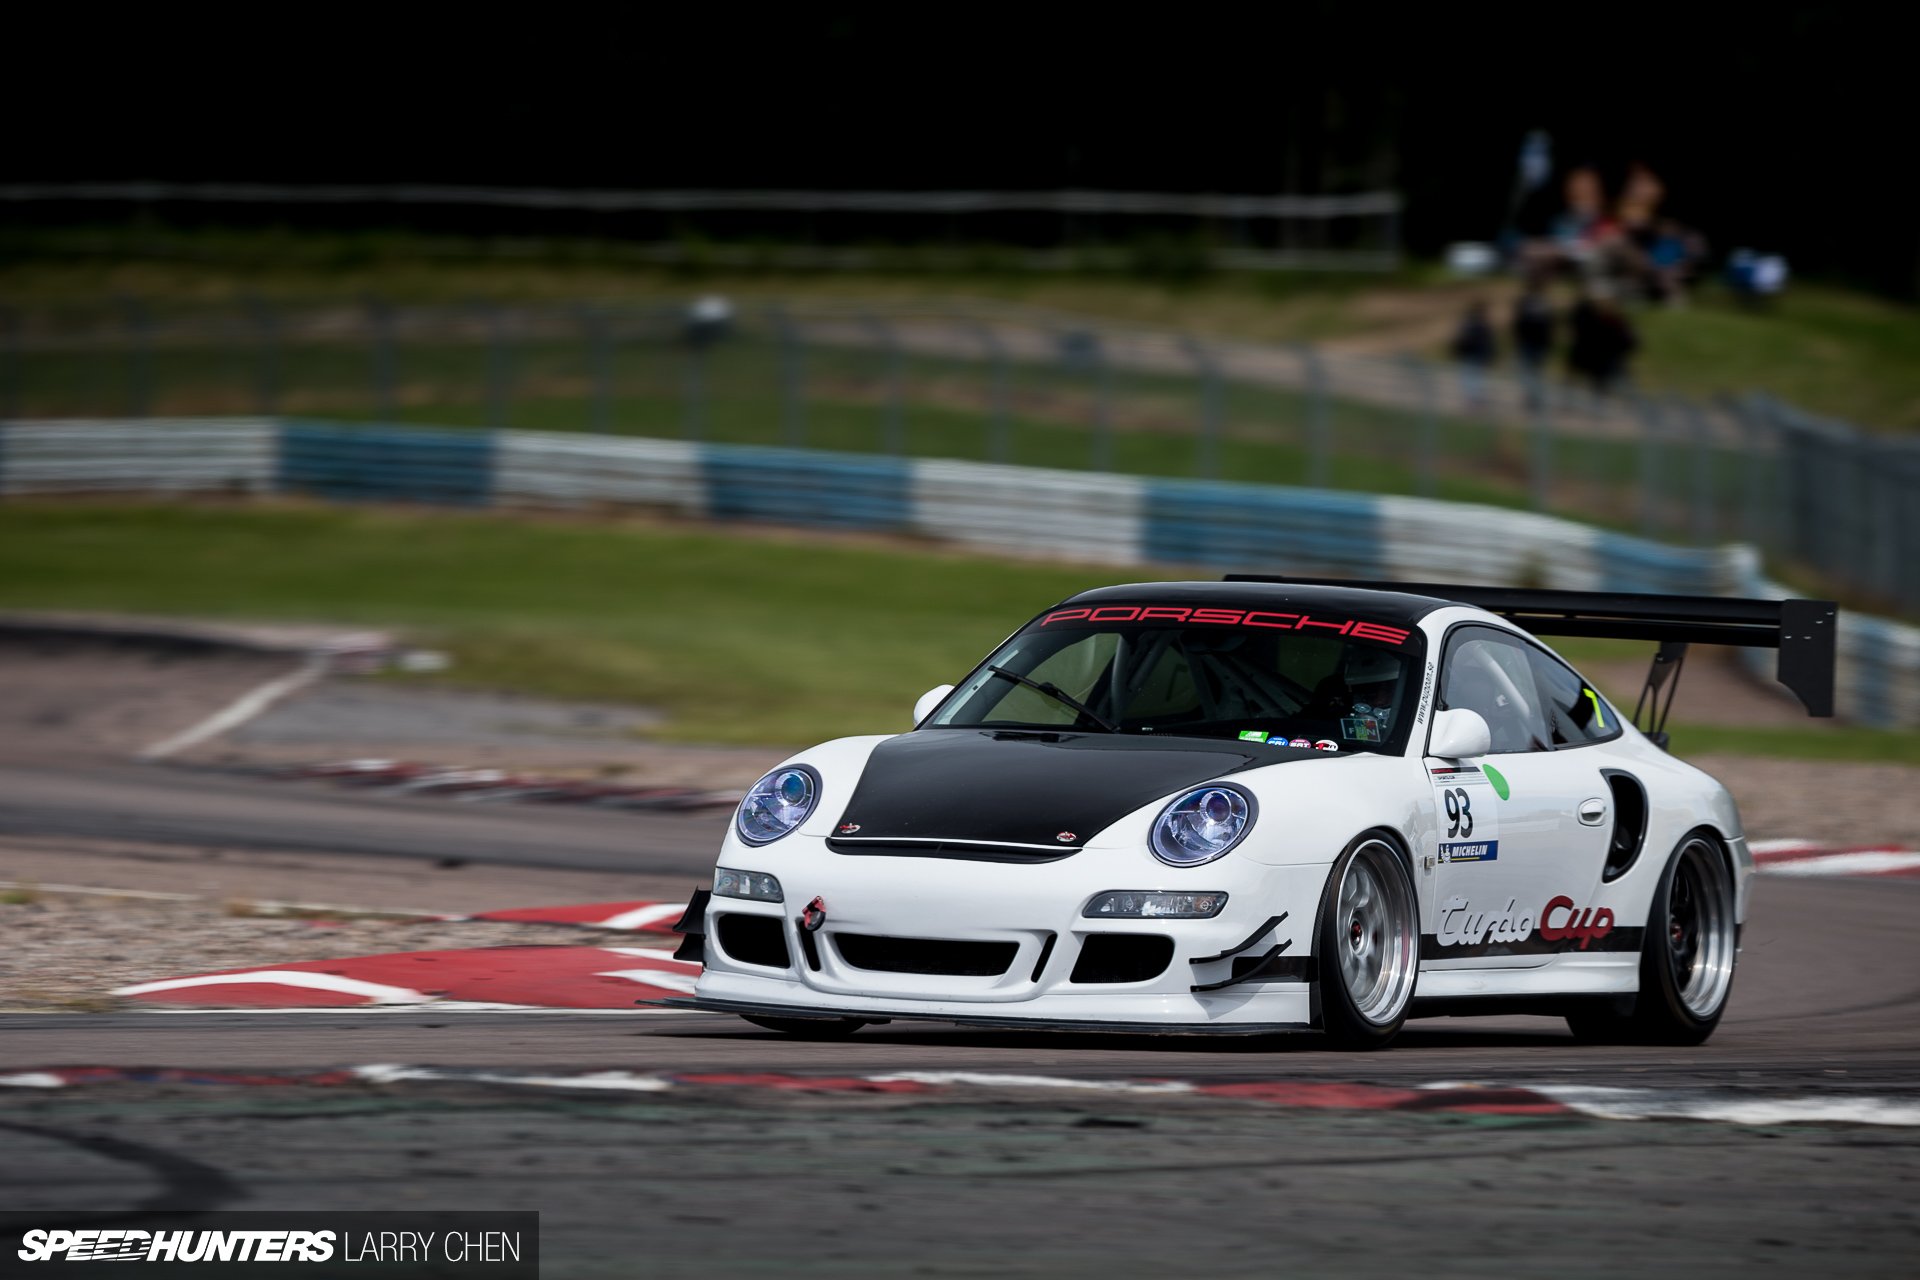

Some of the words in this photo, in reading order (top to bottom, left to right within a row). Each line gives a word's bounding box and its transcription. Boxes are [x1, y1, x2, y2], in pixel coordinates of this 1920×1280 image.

[1040, 606, 1411, 645] PORSCHE
[1444, 787, 1474, 839] 93
[1451, 844, 1488, 857] MICHELIN
[1435, 895, 1536, 947] Turbo
[1539, 895, 1615, 951] Cup
